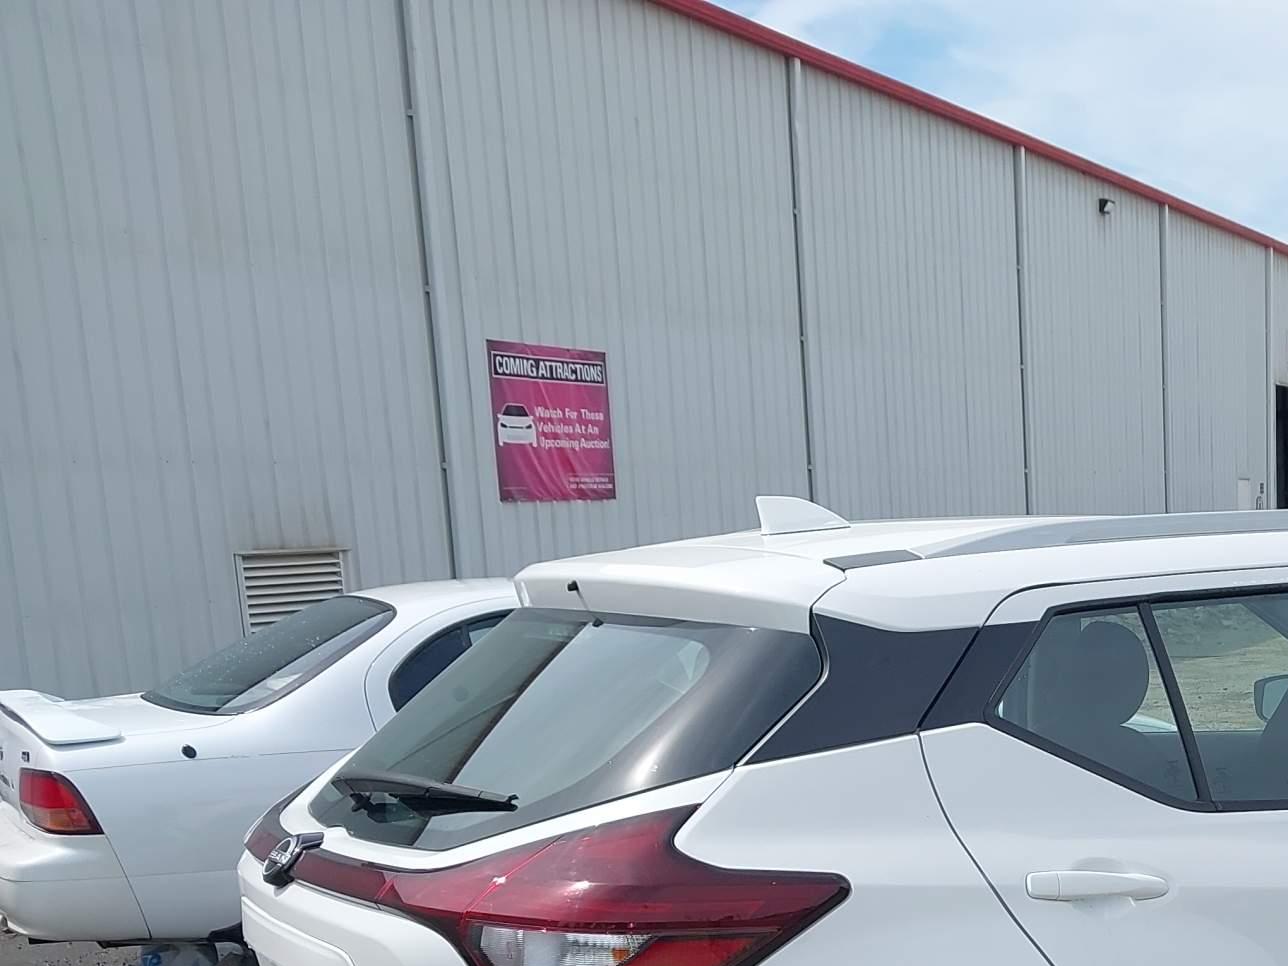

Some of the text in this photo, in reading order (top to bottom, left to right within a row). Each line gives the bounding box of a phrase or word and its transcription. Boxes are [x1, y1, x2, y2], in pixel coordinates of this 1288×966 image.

[495, 356, 602, 382] COMING ATTRACTIONS
[535, 406, 604, 420] Watch For These
[537, 421, 599, 434] Vehicles At An
[540, 436, 610, 451] Upcoming Auction!
